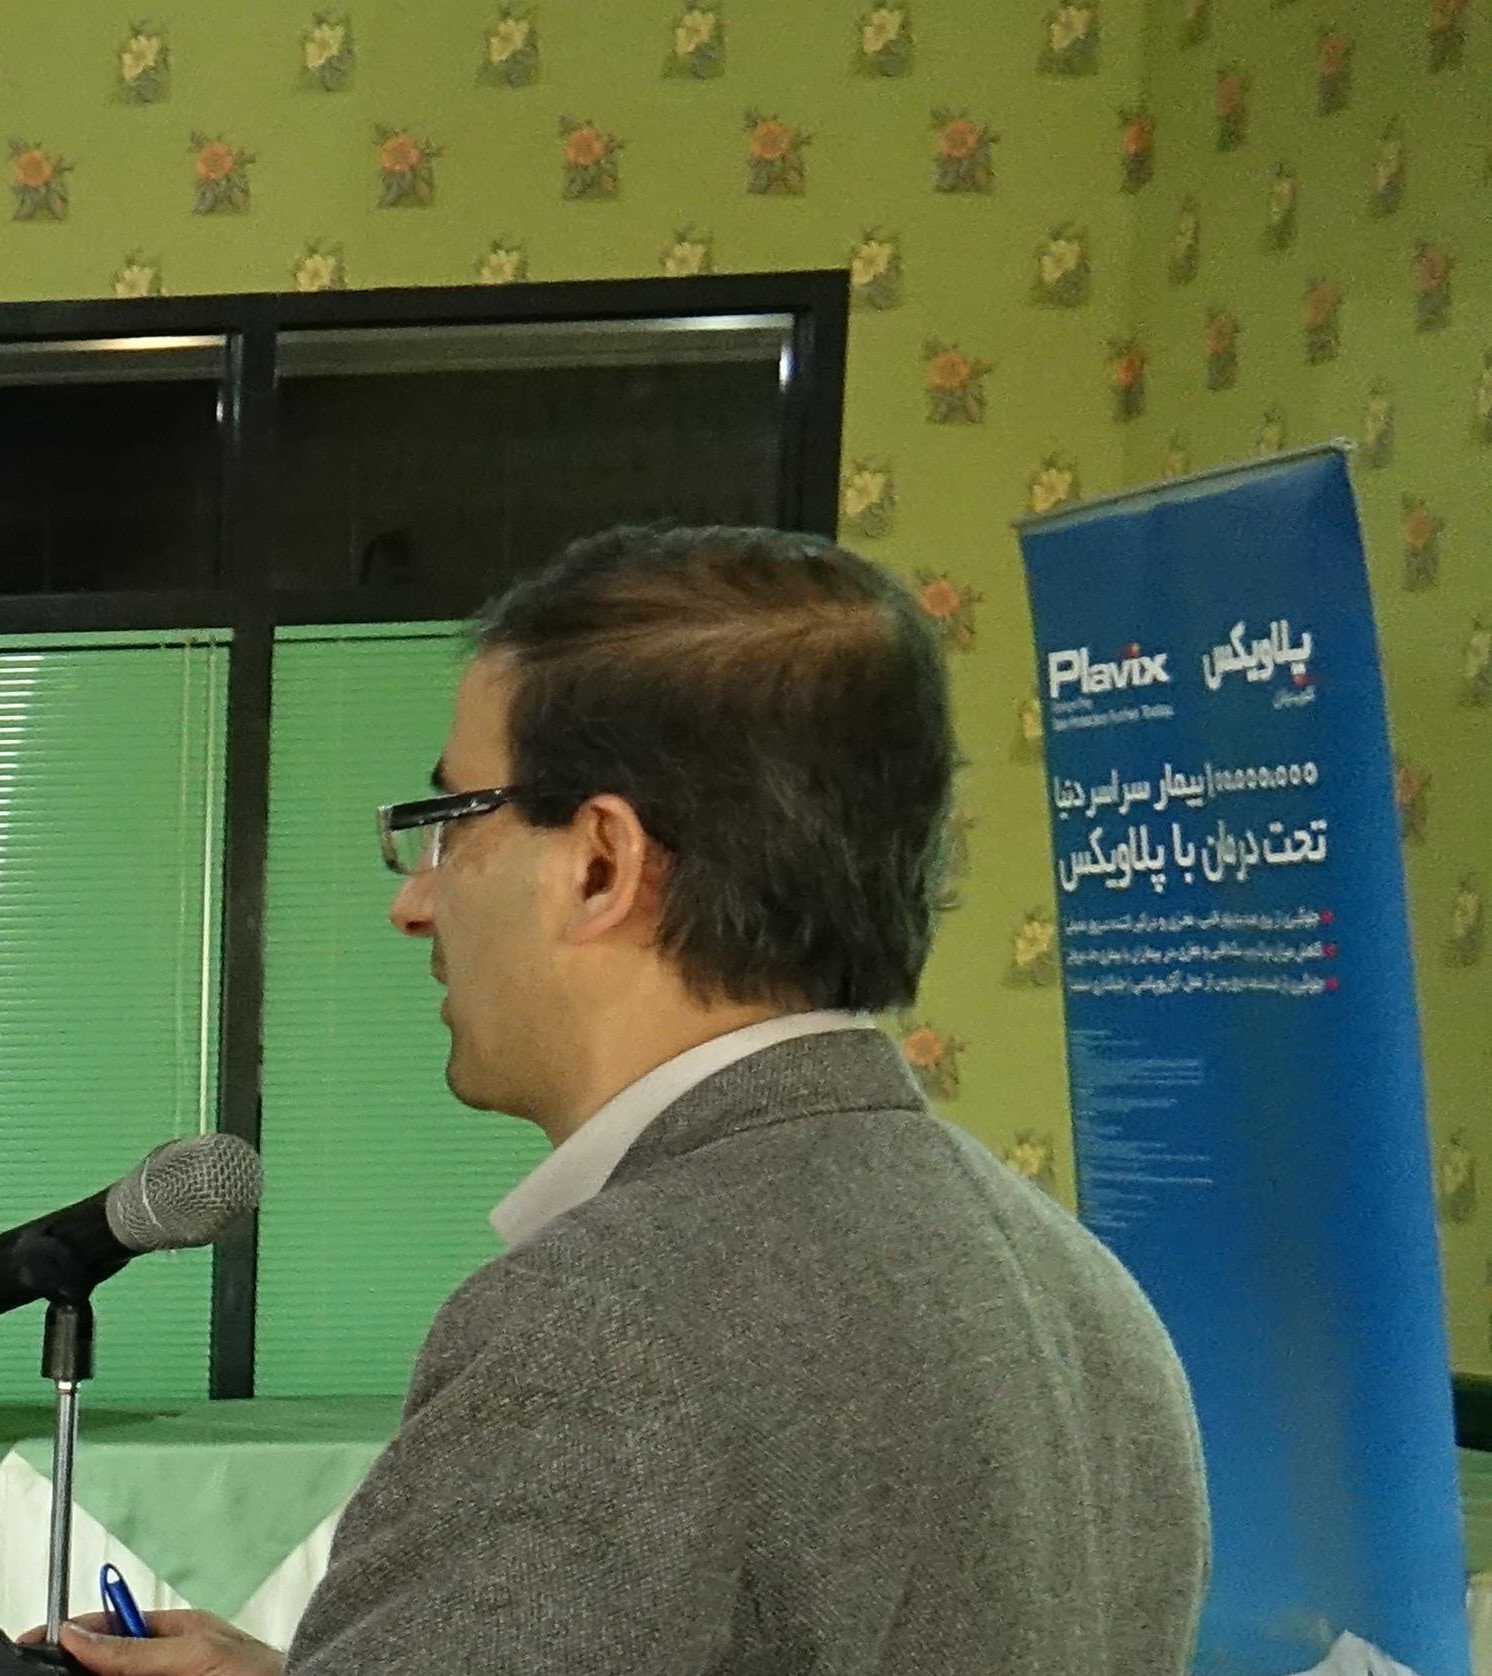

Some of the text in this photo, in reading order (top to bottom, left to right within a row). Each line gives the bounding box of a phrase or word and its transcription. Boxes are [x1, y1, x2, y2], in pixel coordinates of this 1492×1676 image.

[1048, 643, 1171, 698] Plavix
[1202, 619, 1313, 690] پلاویکس
[1153, 763, 1205, 811] بیمار
[1059, 824, 1167, 893] پلاویکس
[1172, 822, 1195, 884] با
[1262, 819, 1327, 863] تحت
